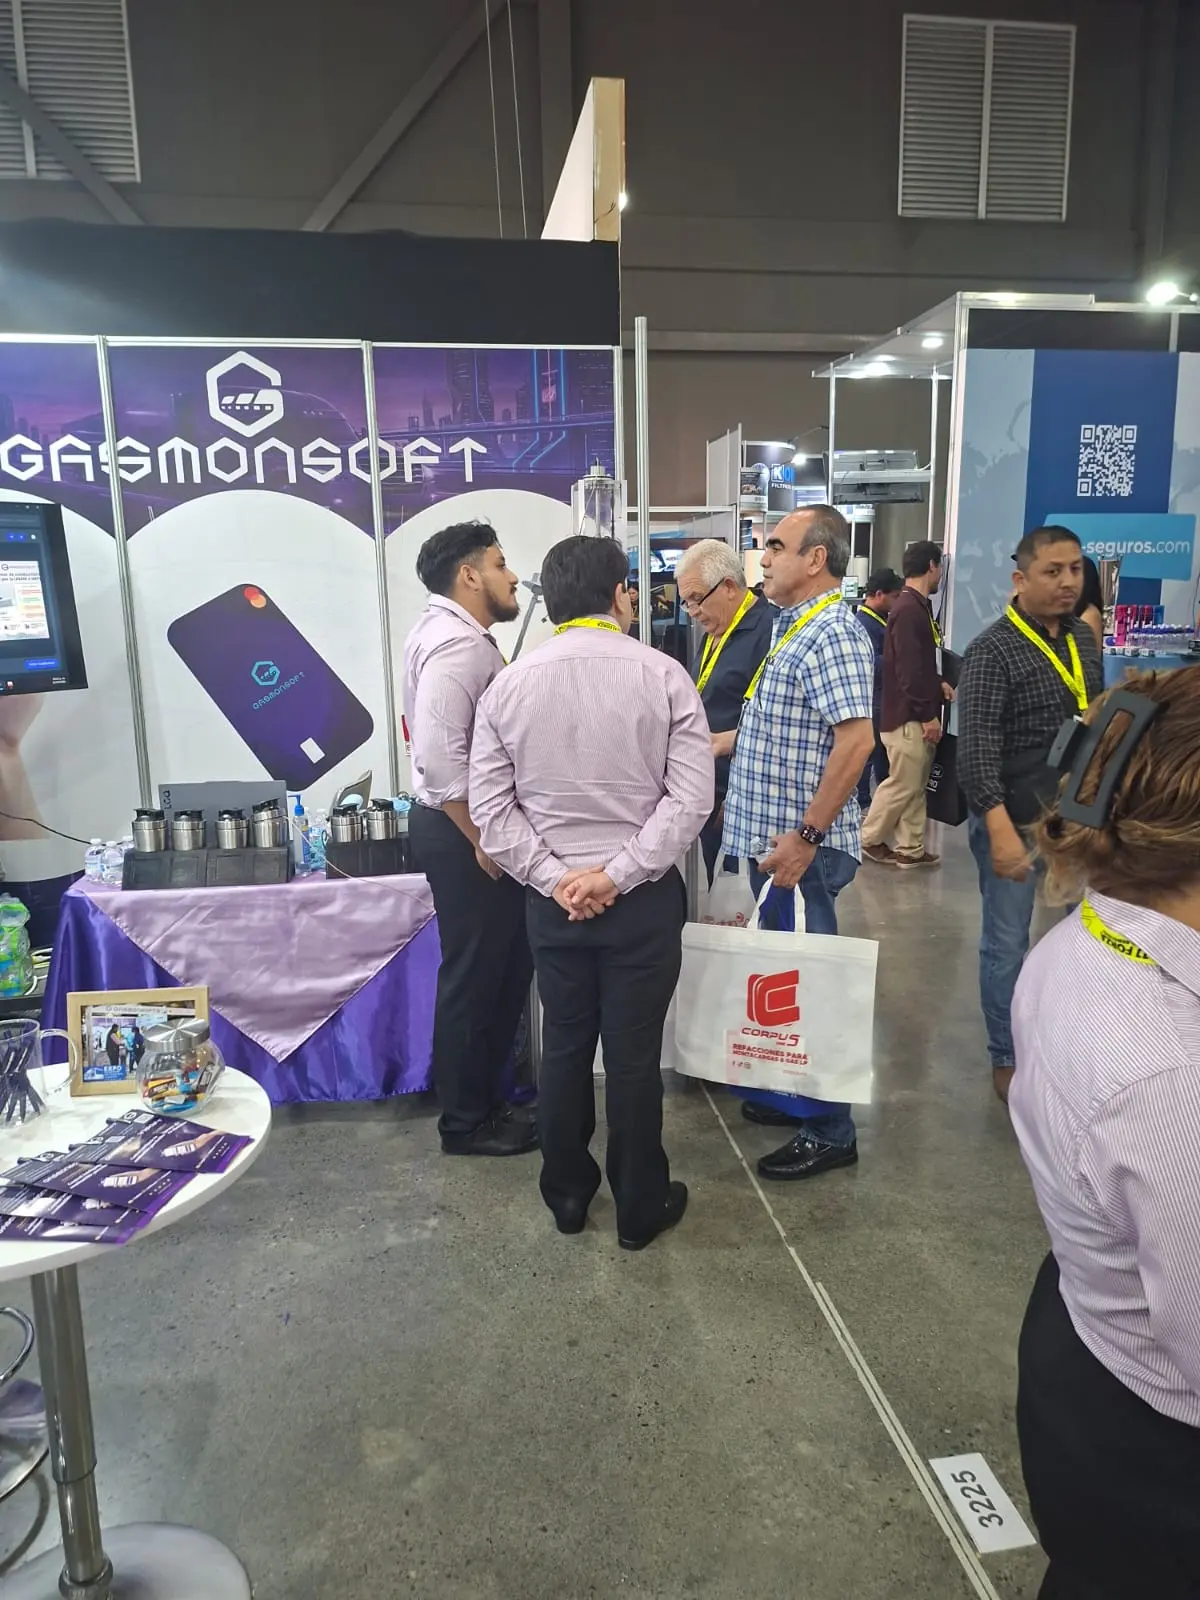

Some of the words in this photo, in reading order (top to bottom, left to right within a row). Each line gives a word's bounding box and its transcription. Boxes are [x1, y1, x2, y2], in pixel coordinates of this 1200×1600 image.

[0, 433, 488, 484] GASMONSOFT
[1081, 540, 1190, 557] -seguros.com
[741, 1027, 801, 1047] CORPUS
[732, 1043, 784, 1057] REFACCIONES
[785, 1051, 808, 1060] PARA
[950, 1470, 1004, 1528] 3225
